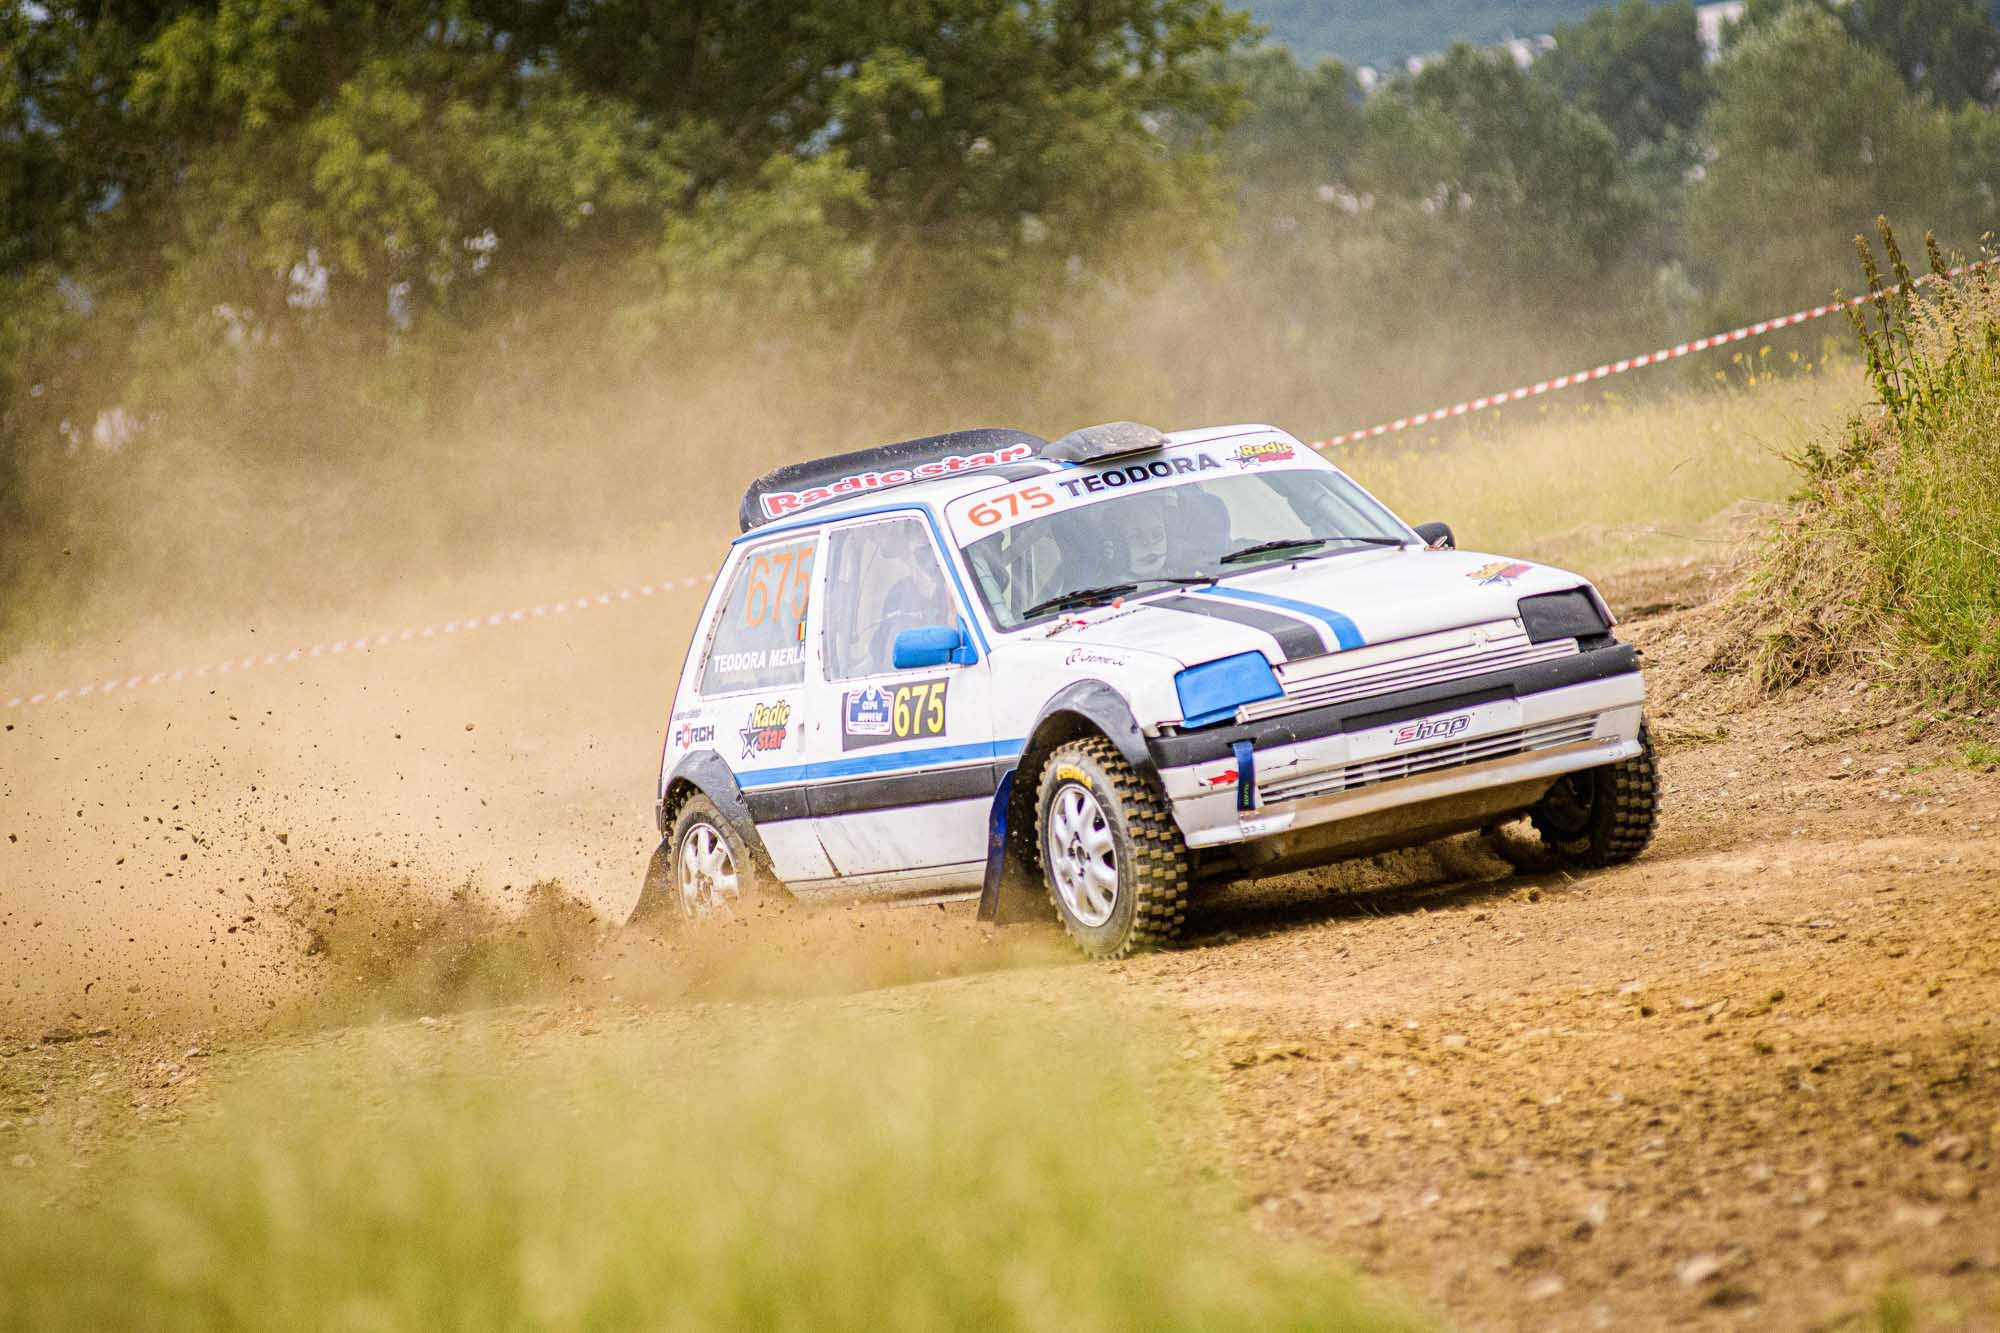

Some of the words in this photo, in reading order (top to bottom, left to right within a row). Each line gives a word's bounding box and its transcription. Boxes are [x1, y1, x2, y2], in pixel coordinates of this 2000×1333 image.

[765, 470, 906, 515] Radic
[920, 446, 1025, 476] star
[967, 486, 1055, 527] 675
[1059, 453, 1222, 498] TEODORA
[744, 547, 813, 628] 675
[713, 650, 766, 673] TEODORA
[753, 699, 791, 730] Radic
[893, 682, 946, 737] 675
[1396, 716, 1471, 743] shop
[756, 727, 787, 751] star
